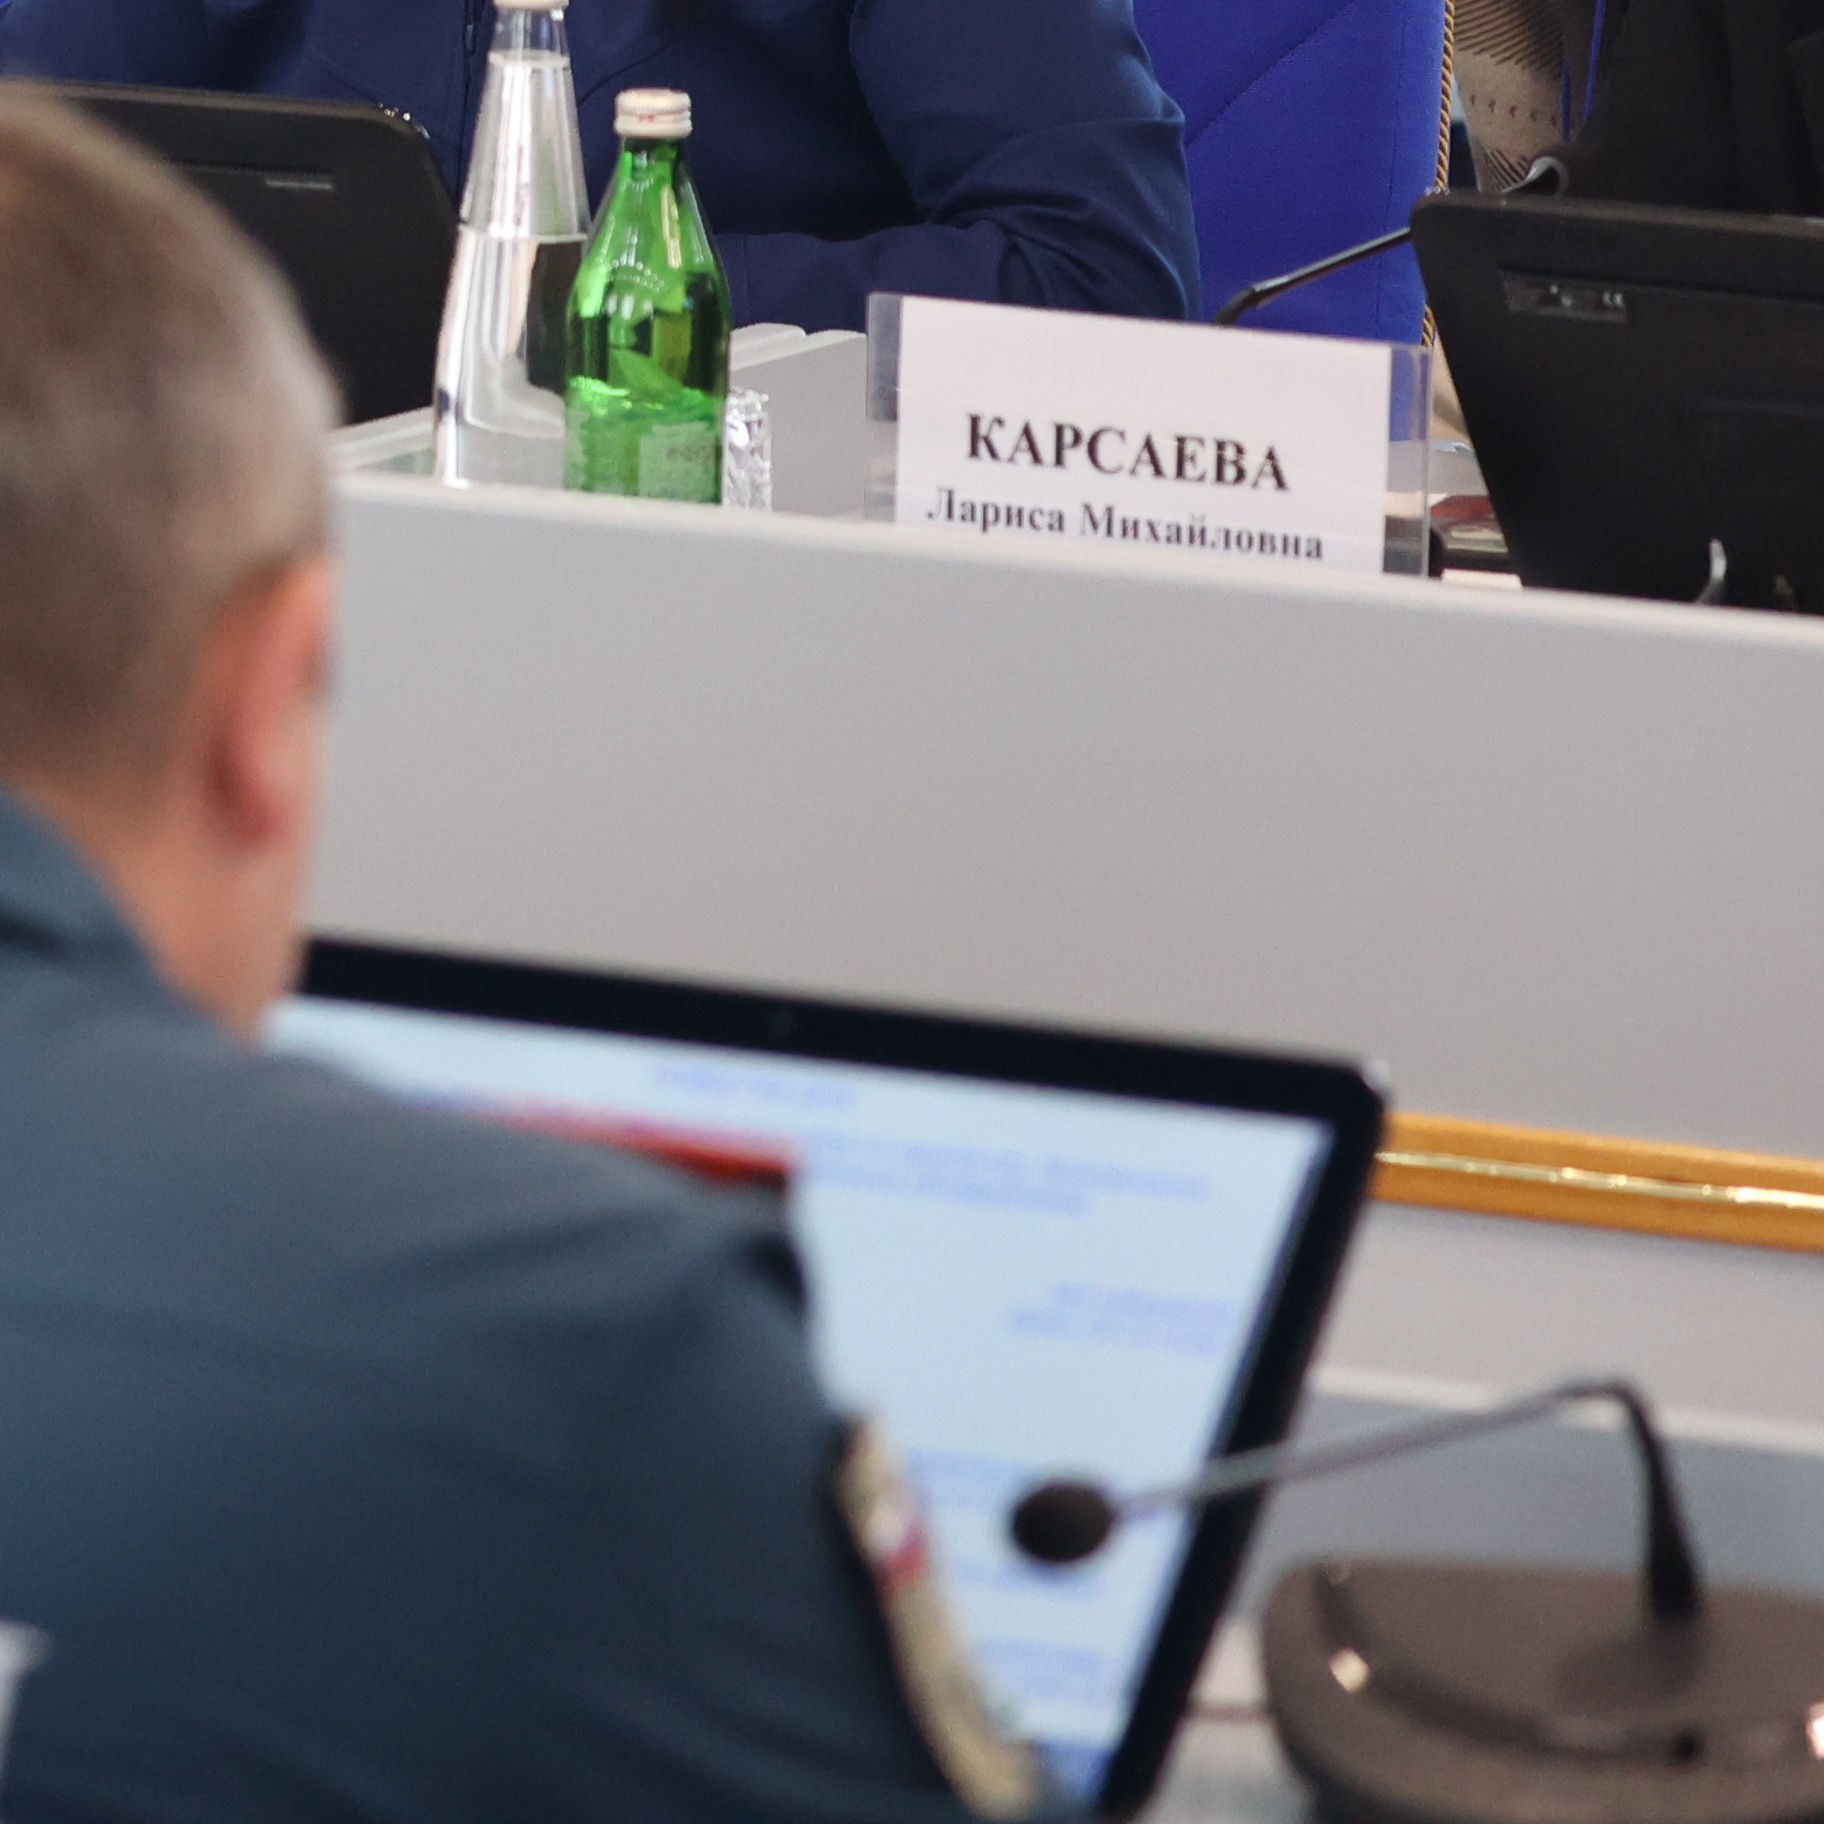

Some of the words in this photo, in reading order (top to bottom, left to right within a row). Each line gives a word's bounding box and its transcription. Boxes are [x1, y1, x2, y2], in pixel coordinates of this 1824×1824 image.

[967, 412, 1290, 492] КАРСАЕВА
[926, 486, 1065, 536] Лариса
[1079, 502, 1324, 560] Михайловна
